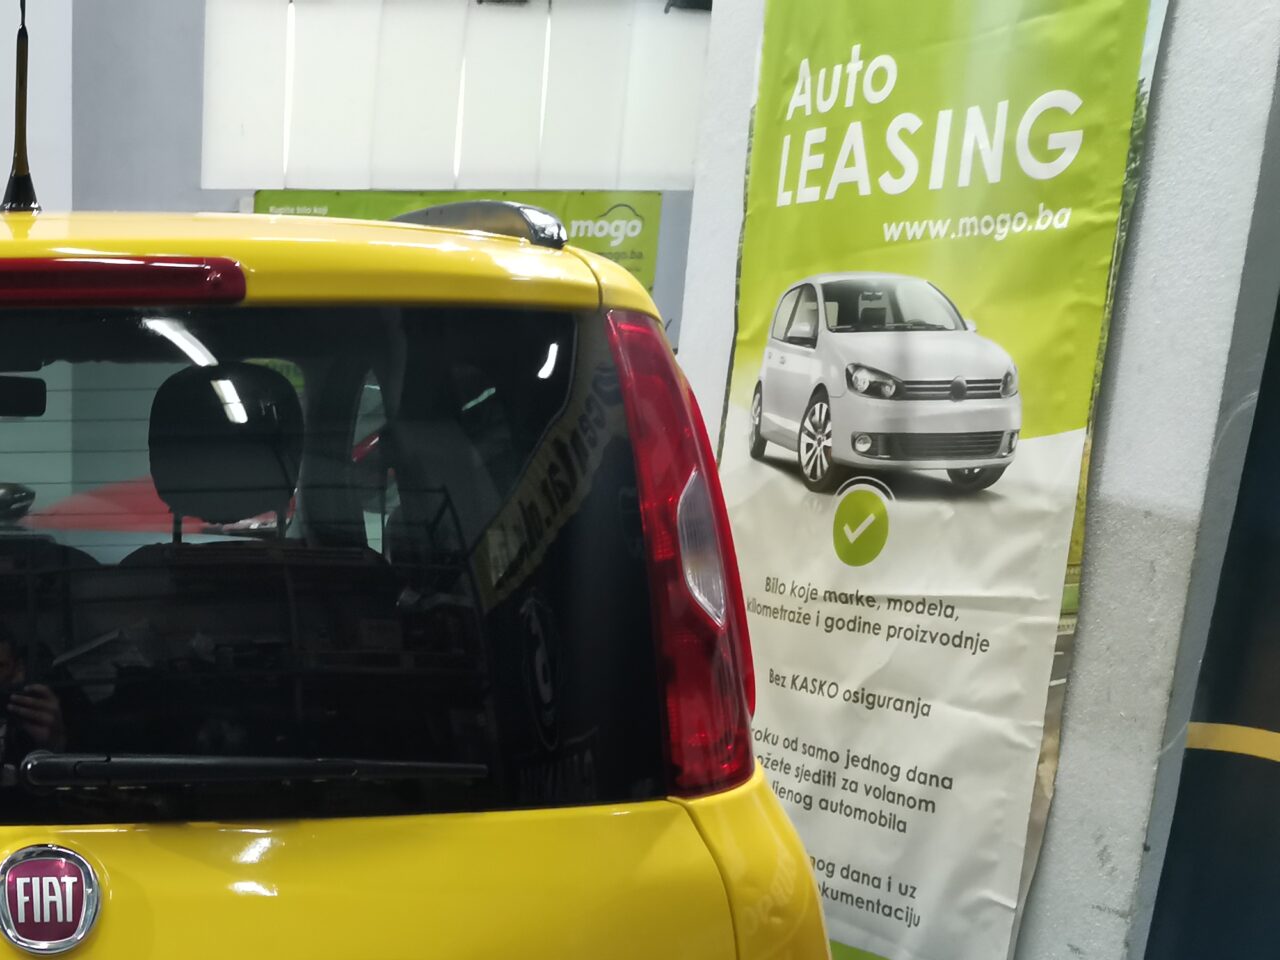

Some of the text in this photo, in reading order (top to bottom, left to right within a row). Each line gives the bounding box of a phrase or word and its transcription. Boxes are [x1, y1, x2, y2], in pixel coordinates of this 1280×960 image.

[786, 43, 898, 121] Auto
[776, 89, 1084, 207] LEASING
[571, 219, 642, 247] mogo
[883, 202, 1072, 242] www.mogo.ba
[765, 577, 959, 622] Bilo koje marke, modela,
[747, 598, 990, 656] kilometraže i godine proizvodnje
[769, 668, 931, 719] Bez KASKO osiguranja
[751, 727, 953, 790] oku od samo jednog dana
[794, 764, 836, 788] sjediti
[841, 776, 858, 793] za
[864, 784, 936, 814] volanom
[818, 798, 907, 833] automobila
[16, 875, 77, 923] FIAT
[818, 881, 920, 928] kumentaciju
[840, 864, 881, 889] dana
[887, 876, 892, 892] i
[898, 883, 917, 899] uz
